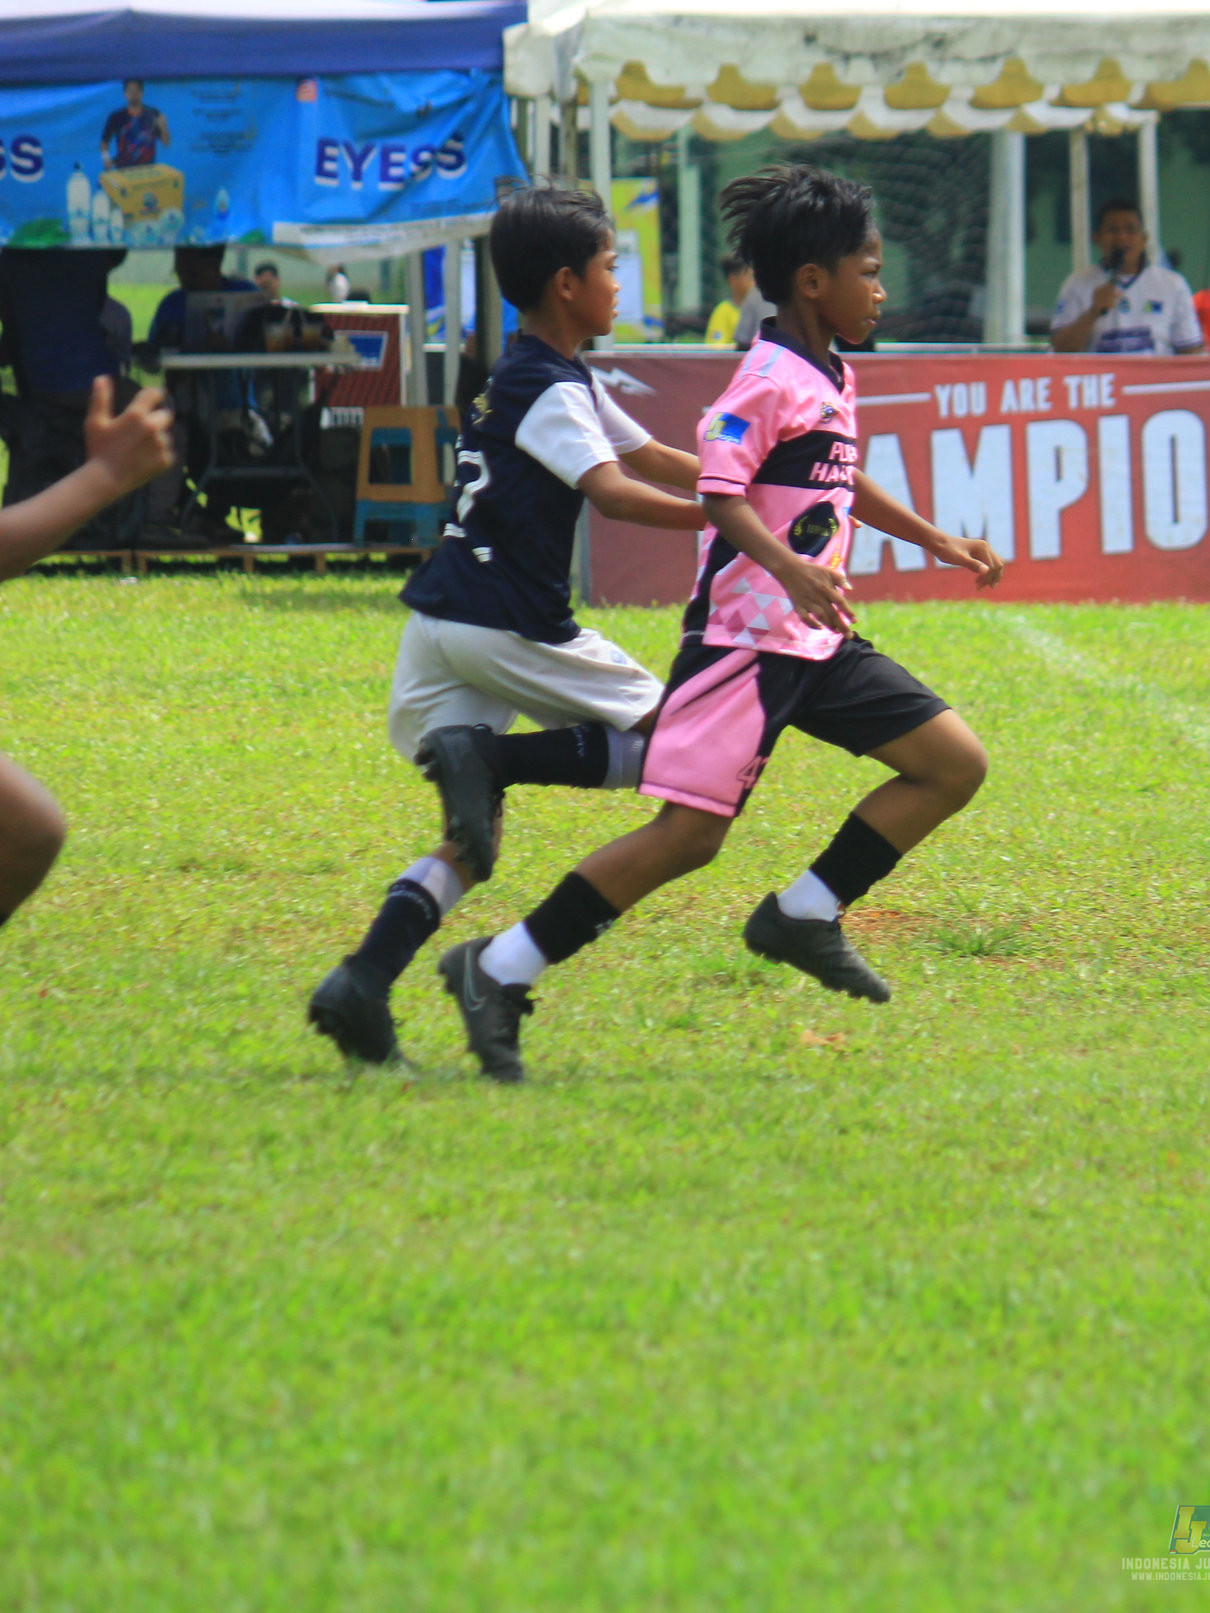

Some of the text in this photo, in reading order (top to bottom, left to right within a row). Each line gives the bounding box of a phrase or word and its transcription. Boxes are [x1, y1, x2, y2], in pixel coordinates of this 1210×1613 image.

[935, 373, 1117, 418] YOU ARE THE
[736, 755, 769, 790] 4
